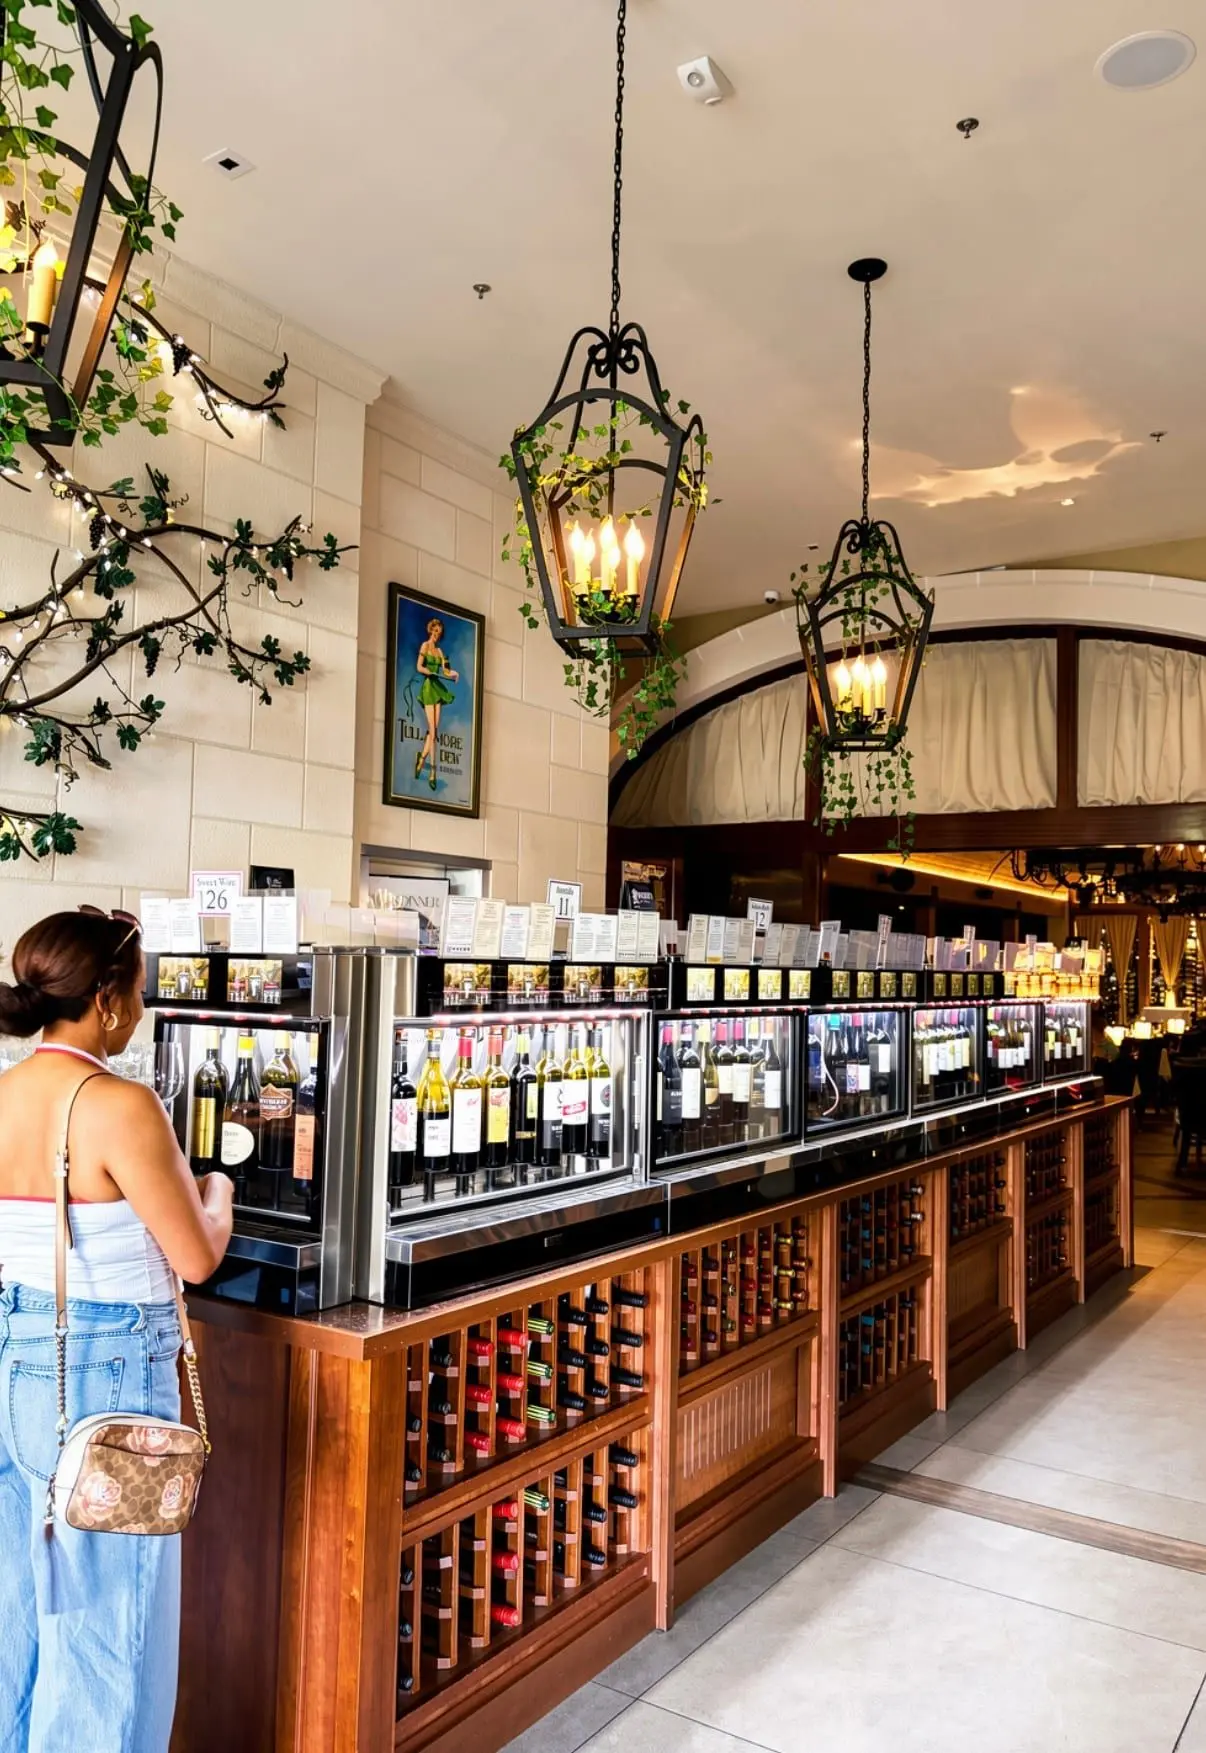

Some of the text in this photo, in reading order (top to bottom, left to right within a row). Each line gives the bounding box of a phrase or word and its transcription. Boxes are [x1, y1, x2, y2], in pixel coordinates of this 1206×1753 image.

[397, 717, 463, 750] TULLMORE
[440, 749, 462, 765] DEW
[206, 889, 228, 910] 26
